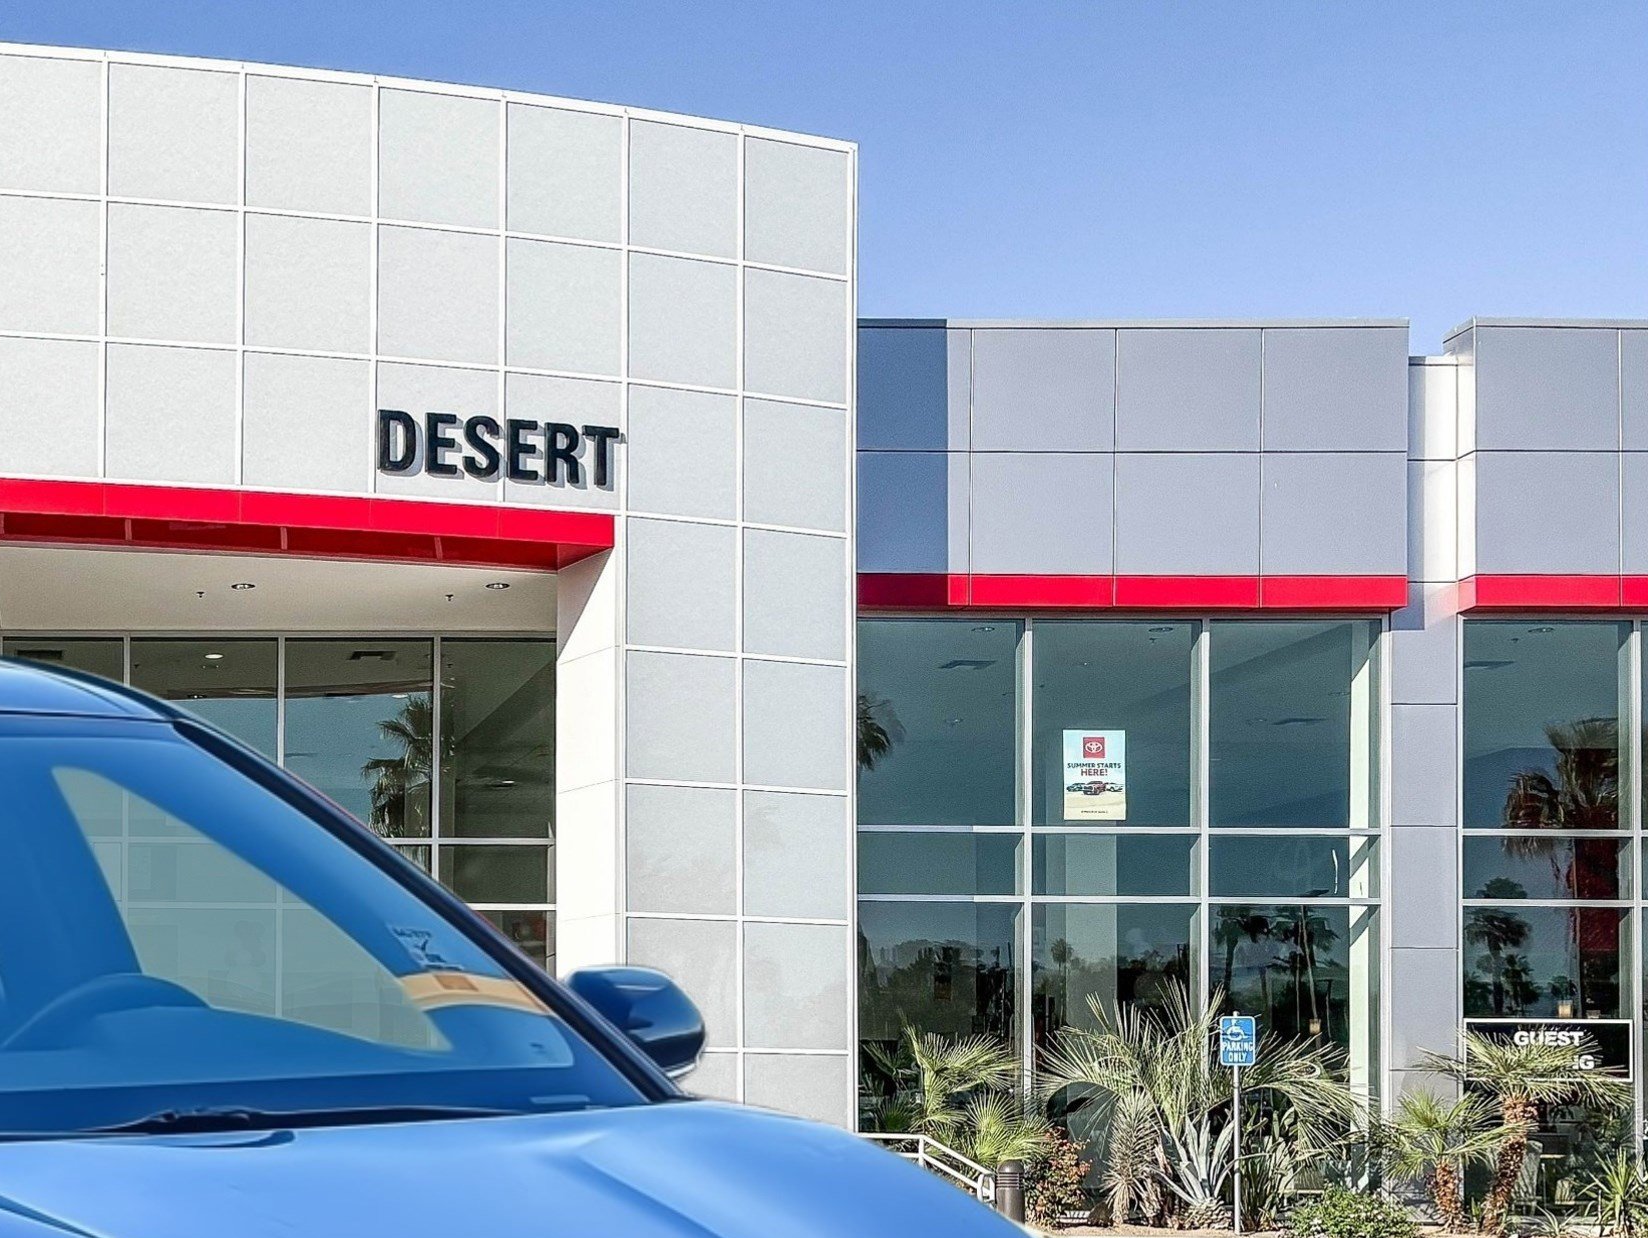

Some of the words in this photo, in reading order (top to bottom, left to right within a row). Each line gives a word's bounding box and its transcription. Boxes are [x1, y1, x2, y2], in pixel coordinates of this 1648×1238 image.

[377, 409, 620, 486] DESERT
[1080, 768, 1108, 777] HERE!
[1514, 1031, 1584, 1047] GUEST
[1222, 1041, 1254, 1052] PARKING
[1228, 1052, 1248, 1063] ONLY
